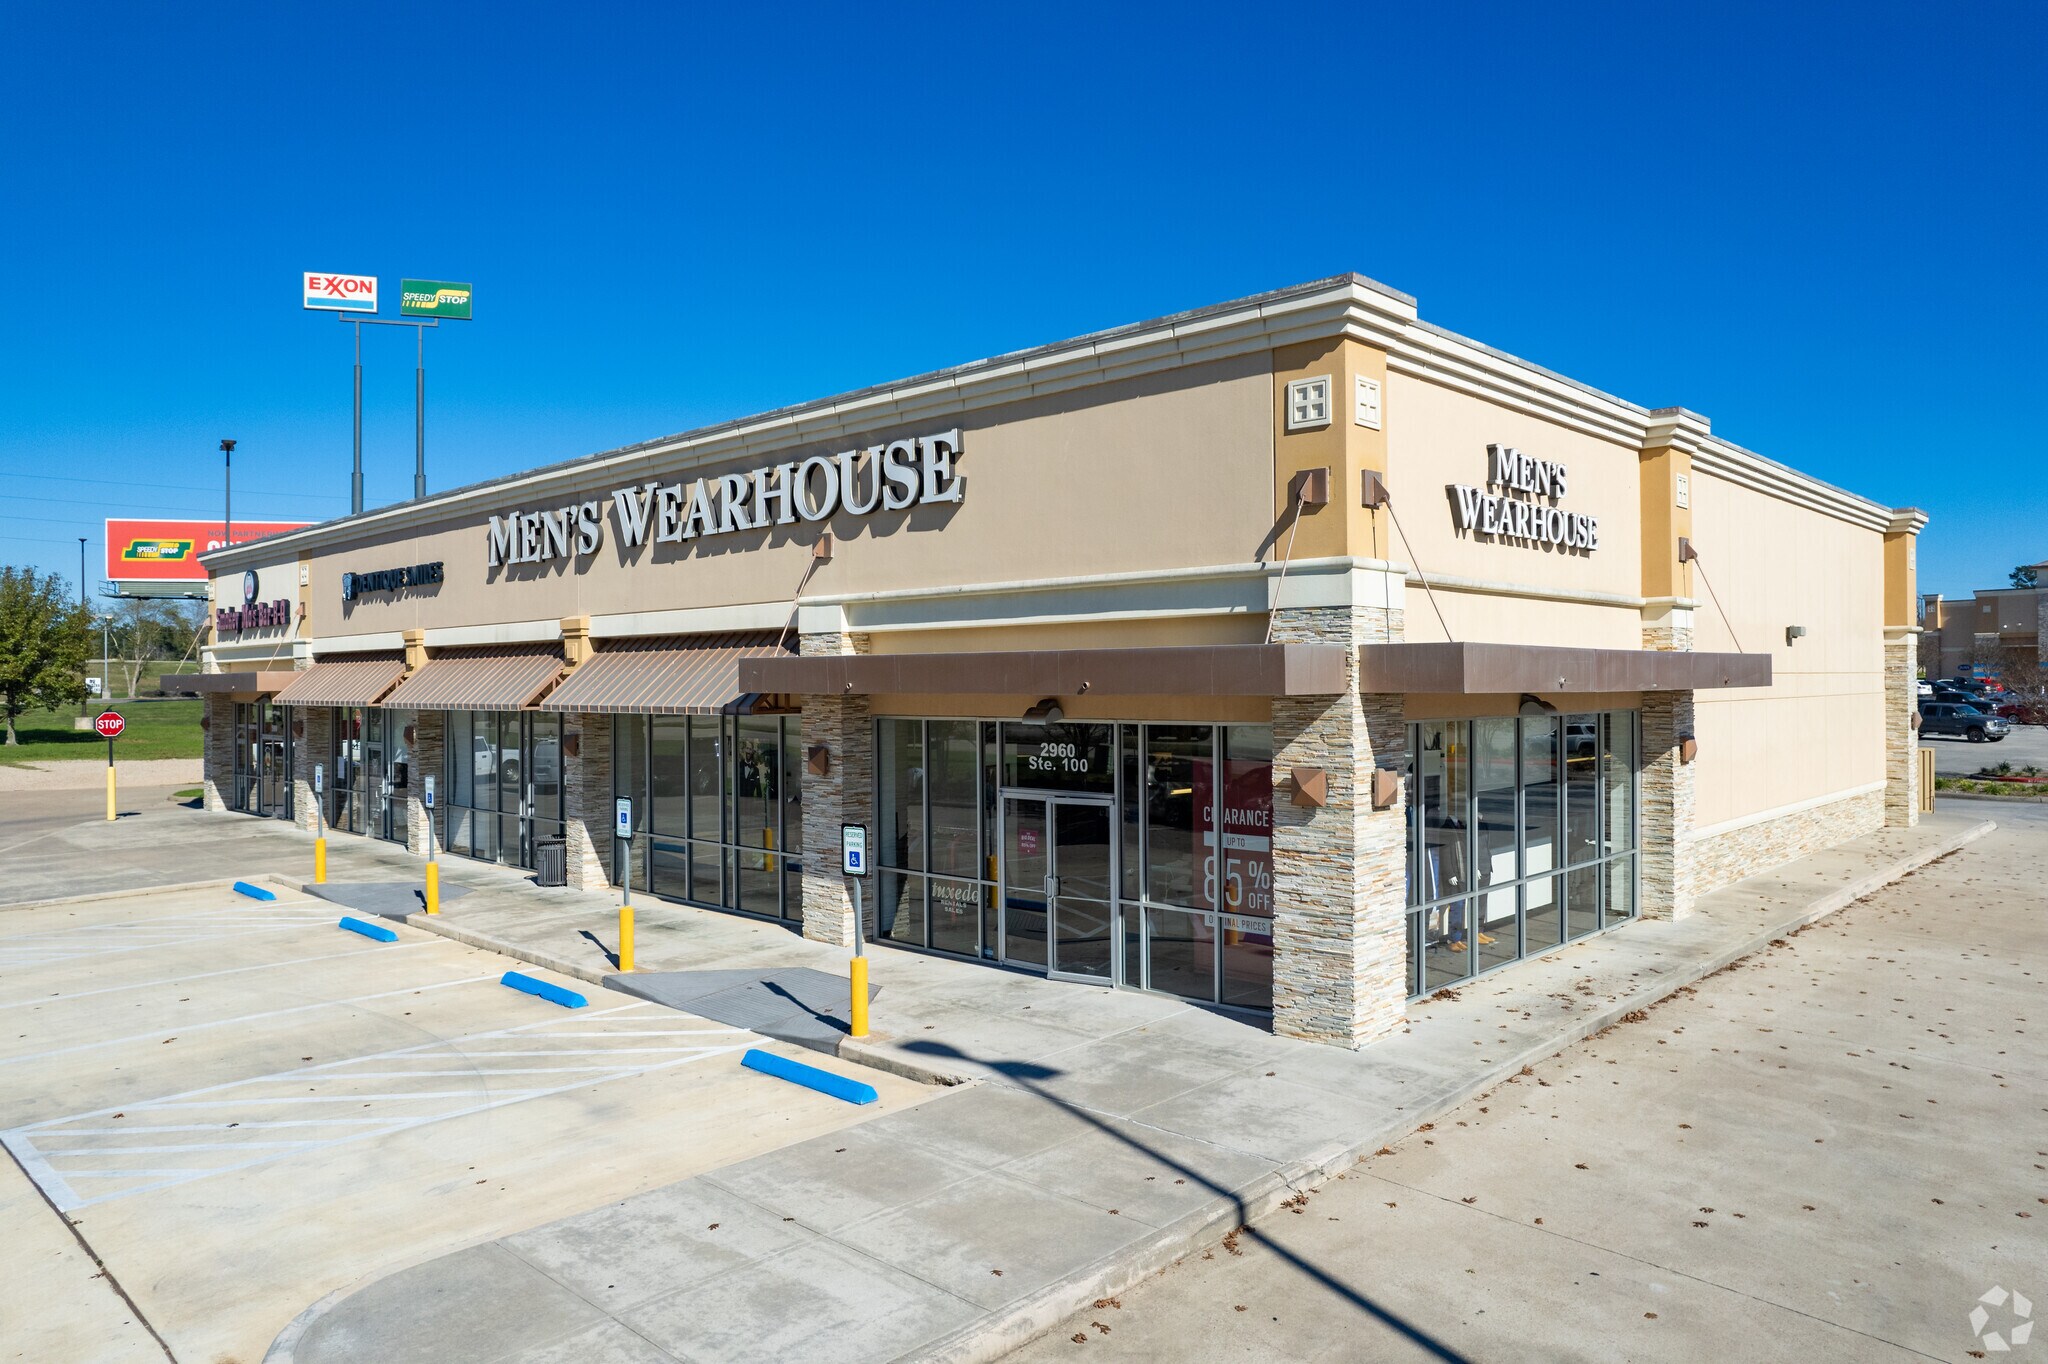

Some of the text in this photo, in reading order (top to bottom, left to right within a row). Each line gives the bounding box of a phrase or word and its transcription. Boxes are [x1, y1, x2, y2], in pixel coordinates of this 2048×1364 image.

[309, 276, 373, 298] EXXON
[403, 292, 468, 305] SPEEDY STOP
[1491, 443, 1568, 499] MEN'S
[488, 427, 965, 568] MEN'S WEARHOUSE
[1450, 484, 1600, 550] WEARHOUSE
[136, 545, 159, 553] SPEEDY
[98, 719, 122, 730] STOP
[1040, 742, 1076, 758] 2960
[1028, 755, 1088, 772] Ste. 100
[1227, 836, 1246, 848] UP TO
[1248, 892, 1270, 911] OFF
[1241, 920, 1267, 932] PRICES
